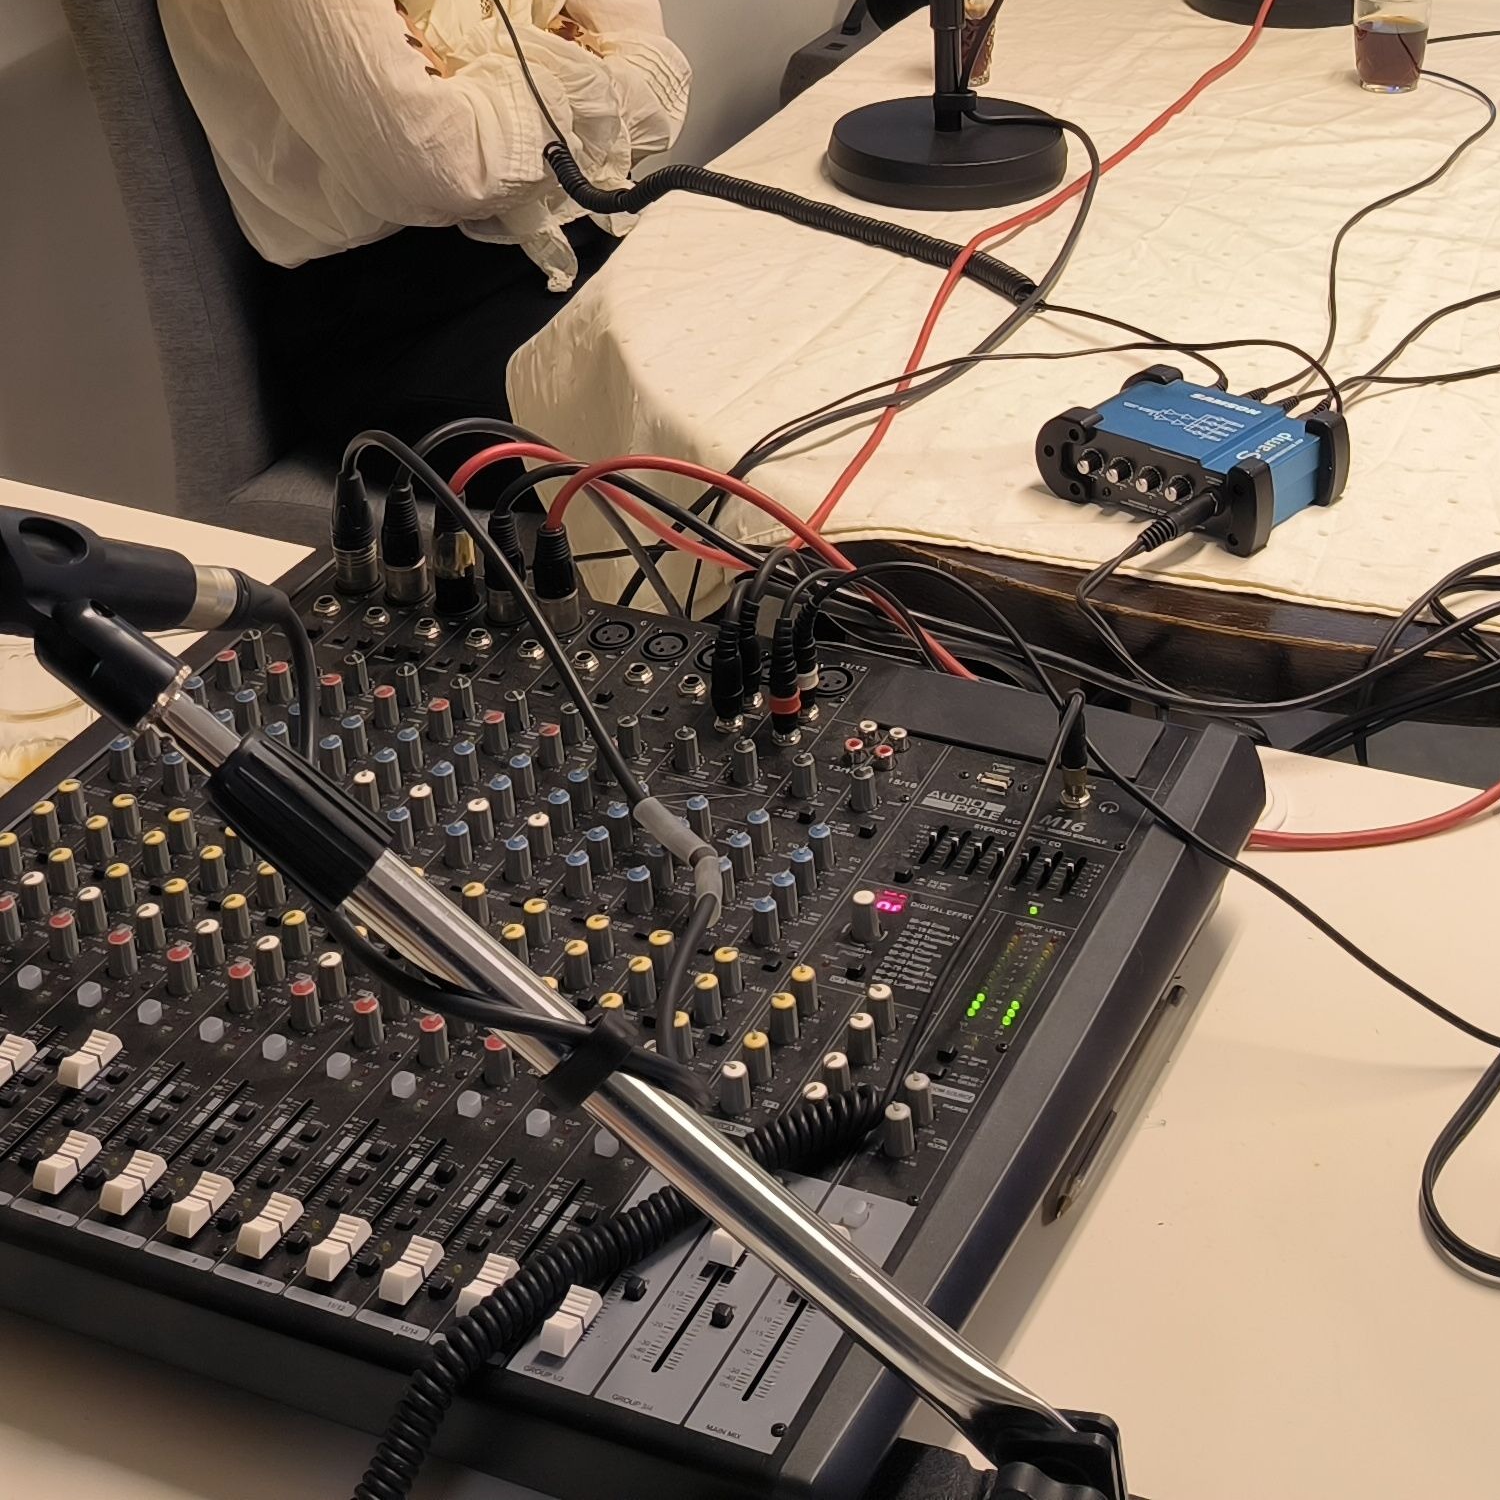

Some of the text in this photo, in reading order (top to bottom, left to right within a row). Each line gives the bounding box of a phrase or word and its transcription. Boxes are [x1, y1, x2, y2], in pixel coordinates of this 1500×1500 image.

[926, 790, 986, 810] AUDIO
[952, 803, 1002, 821] POLE
[1038, 814, 1088, 833] M16
